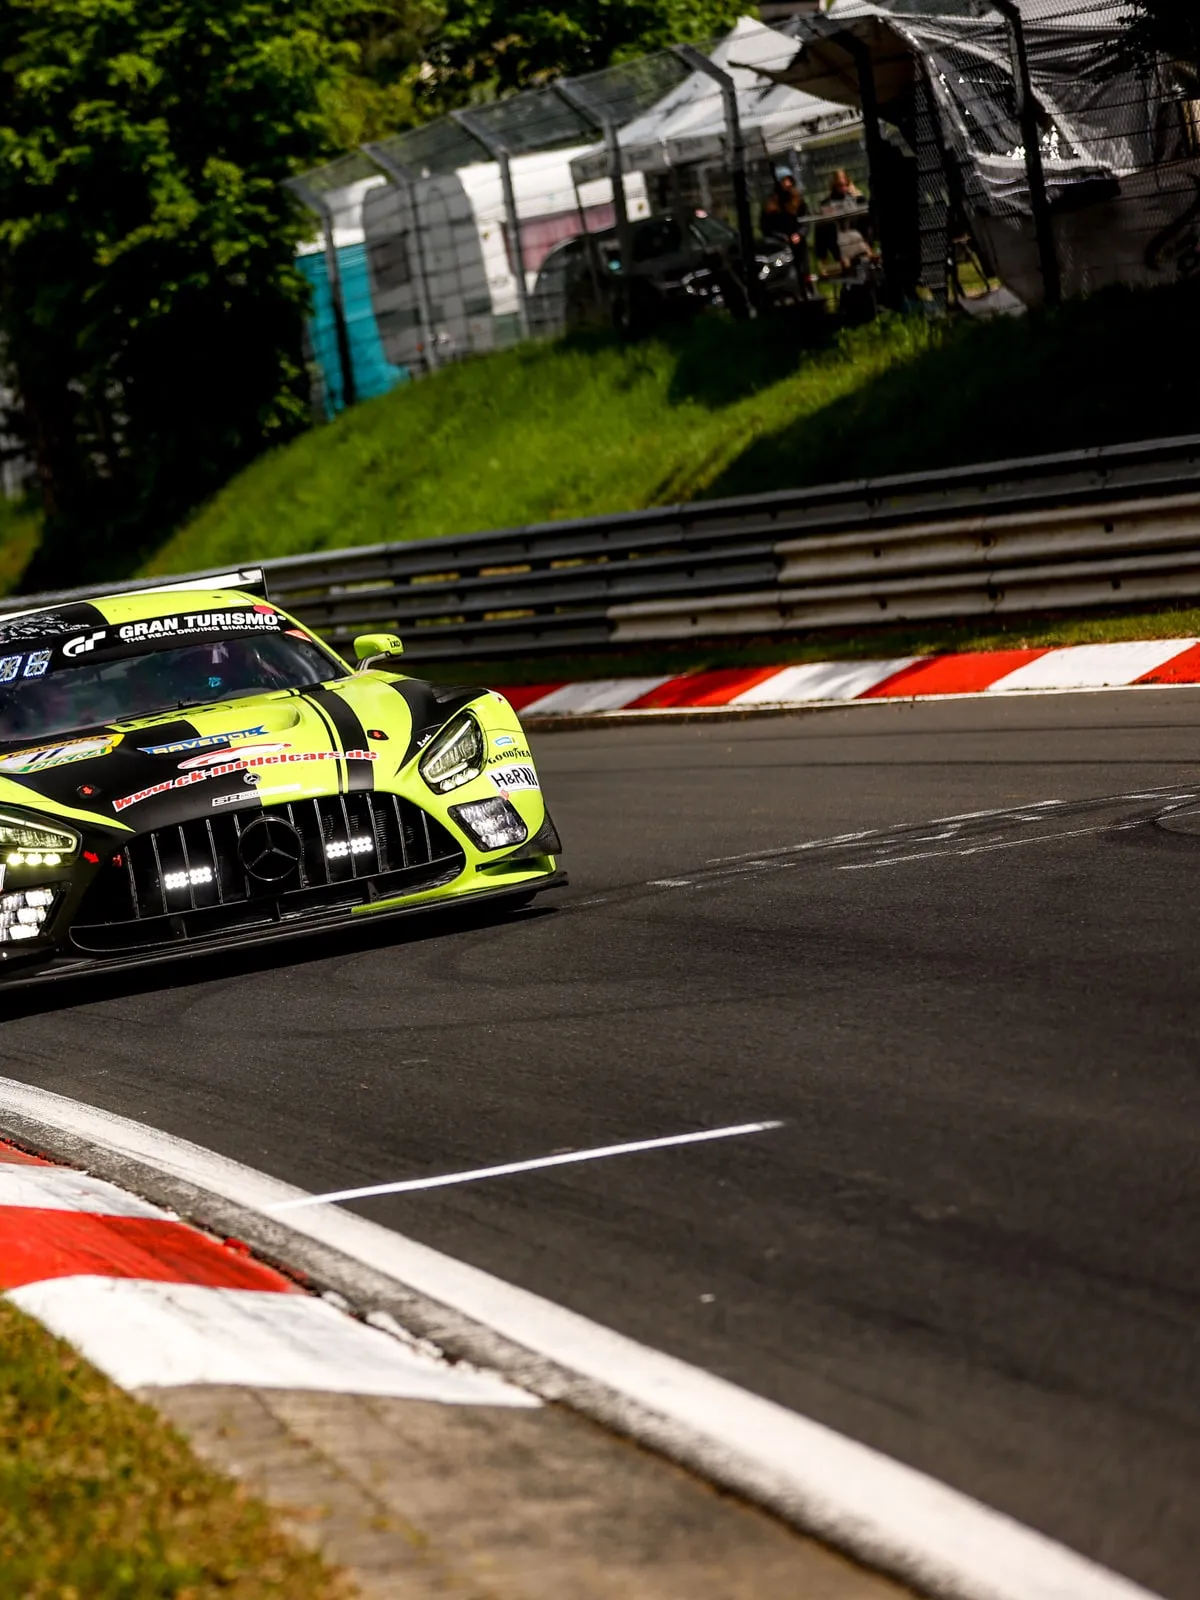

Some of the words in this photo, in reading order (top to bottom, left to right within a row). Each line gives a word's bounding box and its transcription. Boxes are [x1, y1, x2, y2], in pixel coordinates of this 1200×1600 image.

[119, 616, 179, 639] GRAN
[184, 612, 280, 627] TURISMO
[124, 635, 146, 644] THE
[149, 631, 176, 640] REAL
[178, 627, 221, 636] DRIVING
[152, 729, 259, 755] RAVENOL
[487, 748, 531, 764] GOODYEA
[114, 750, 378, 811] www.ck-modelcars.de
[490, 768, 525, 788] H&R
